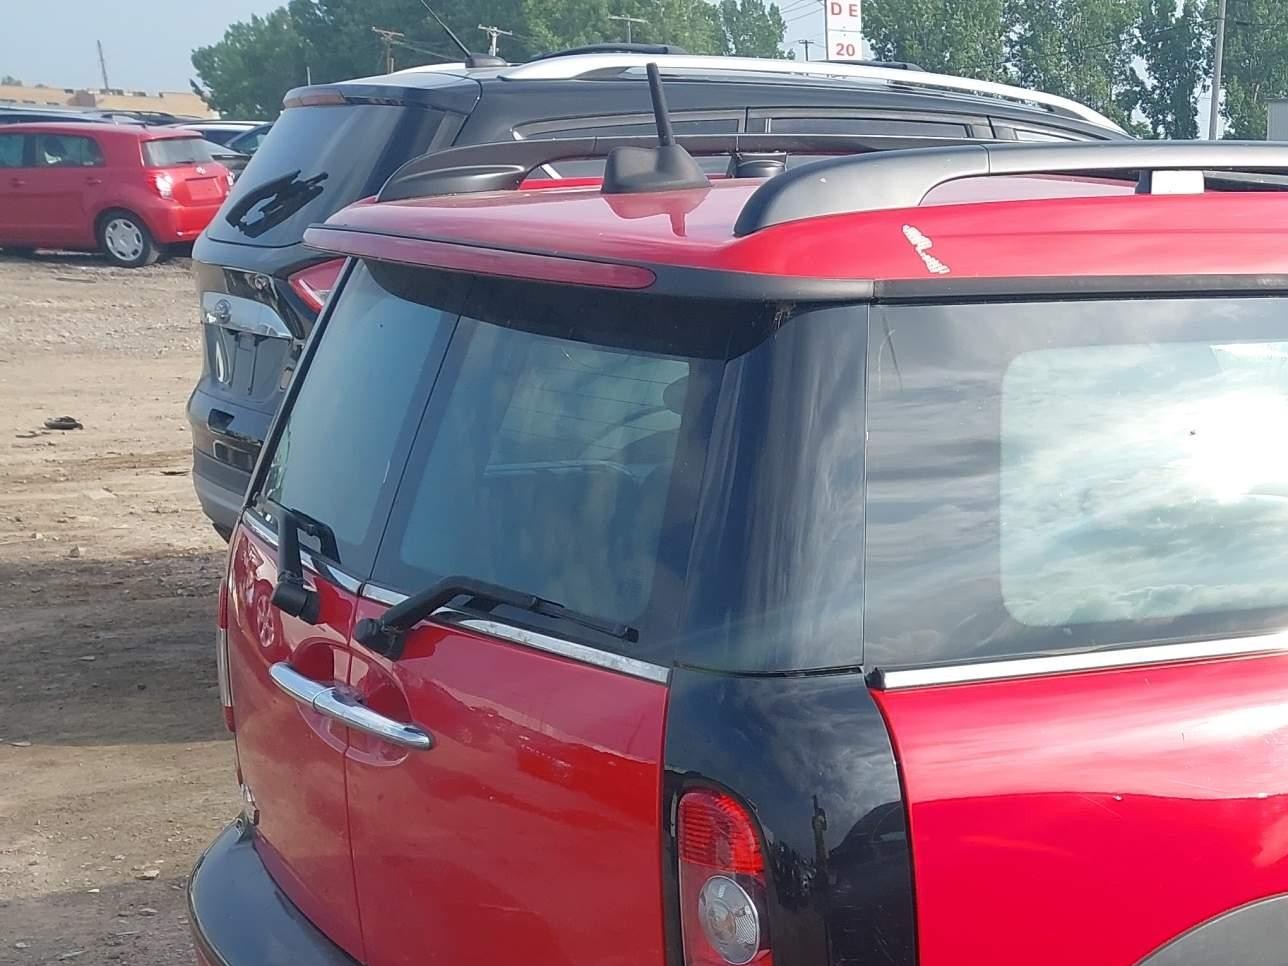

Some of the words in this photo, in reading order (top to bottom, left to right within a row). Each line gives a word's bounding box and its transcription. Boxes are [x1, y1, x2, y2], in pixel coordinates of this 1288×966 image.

[831, 2, 842, 16] D
[849, 4, 858, 17] E
[836, 43, 856, 57] 20
